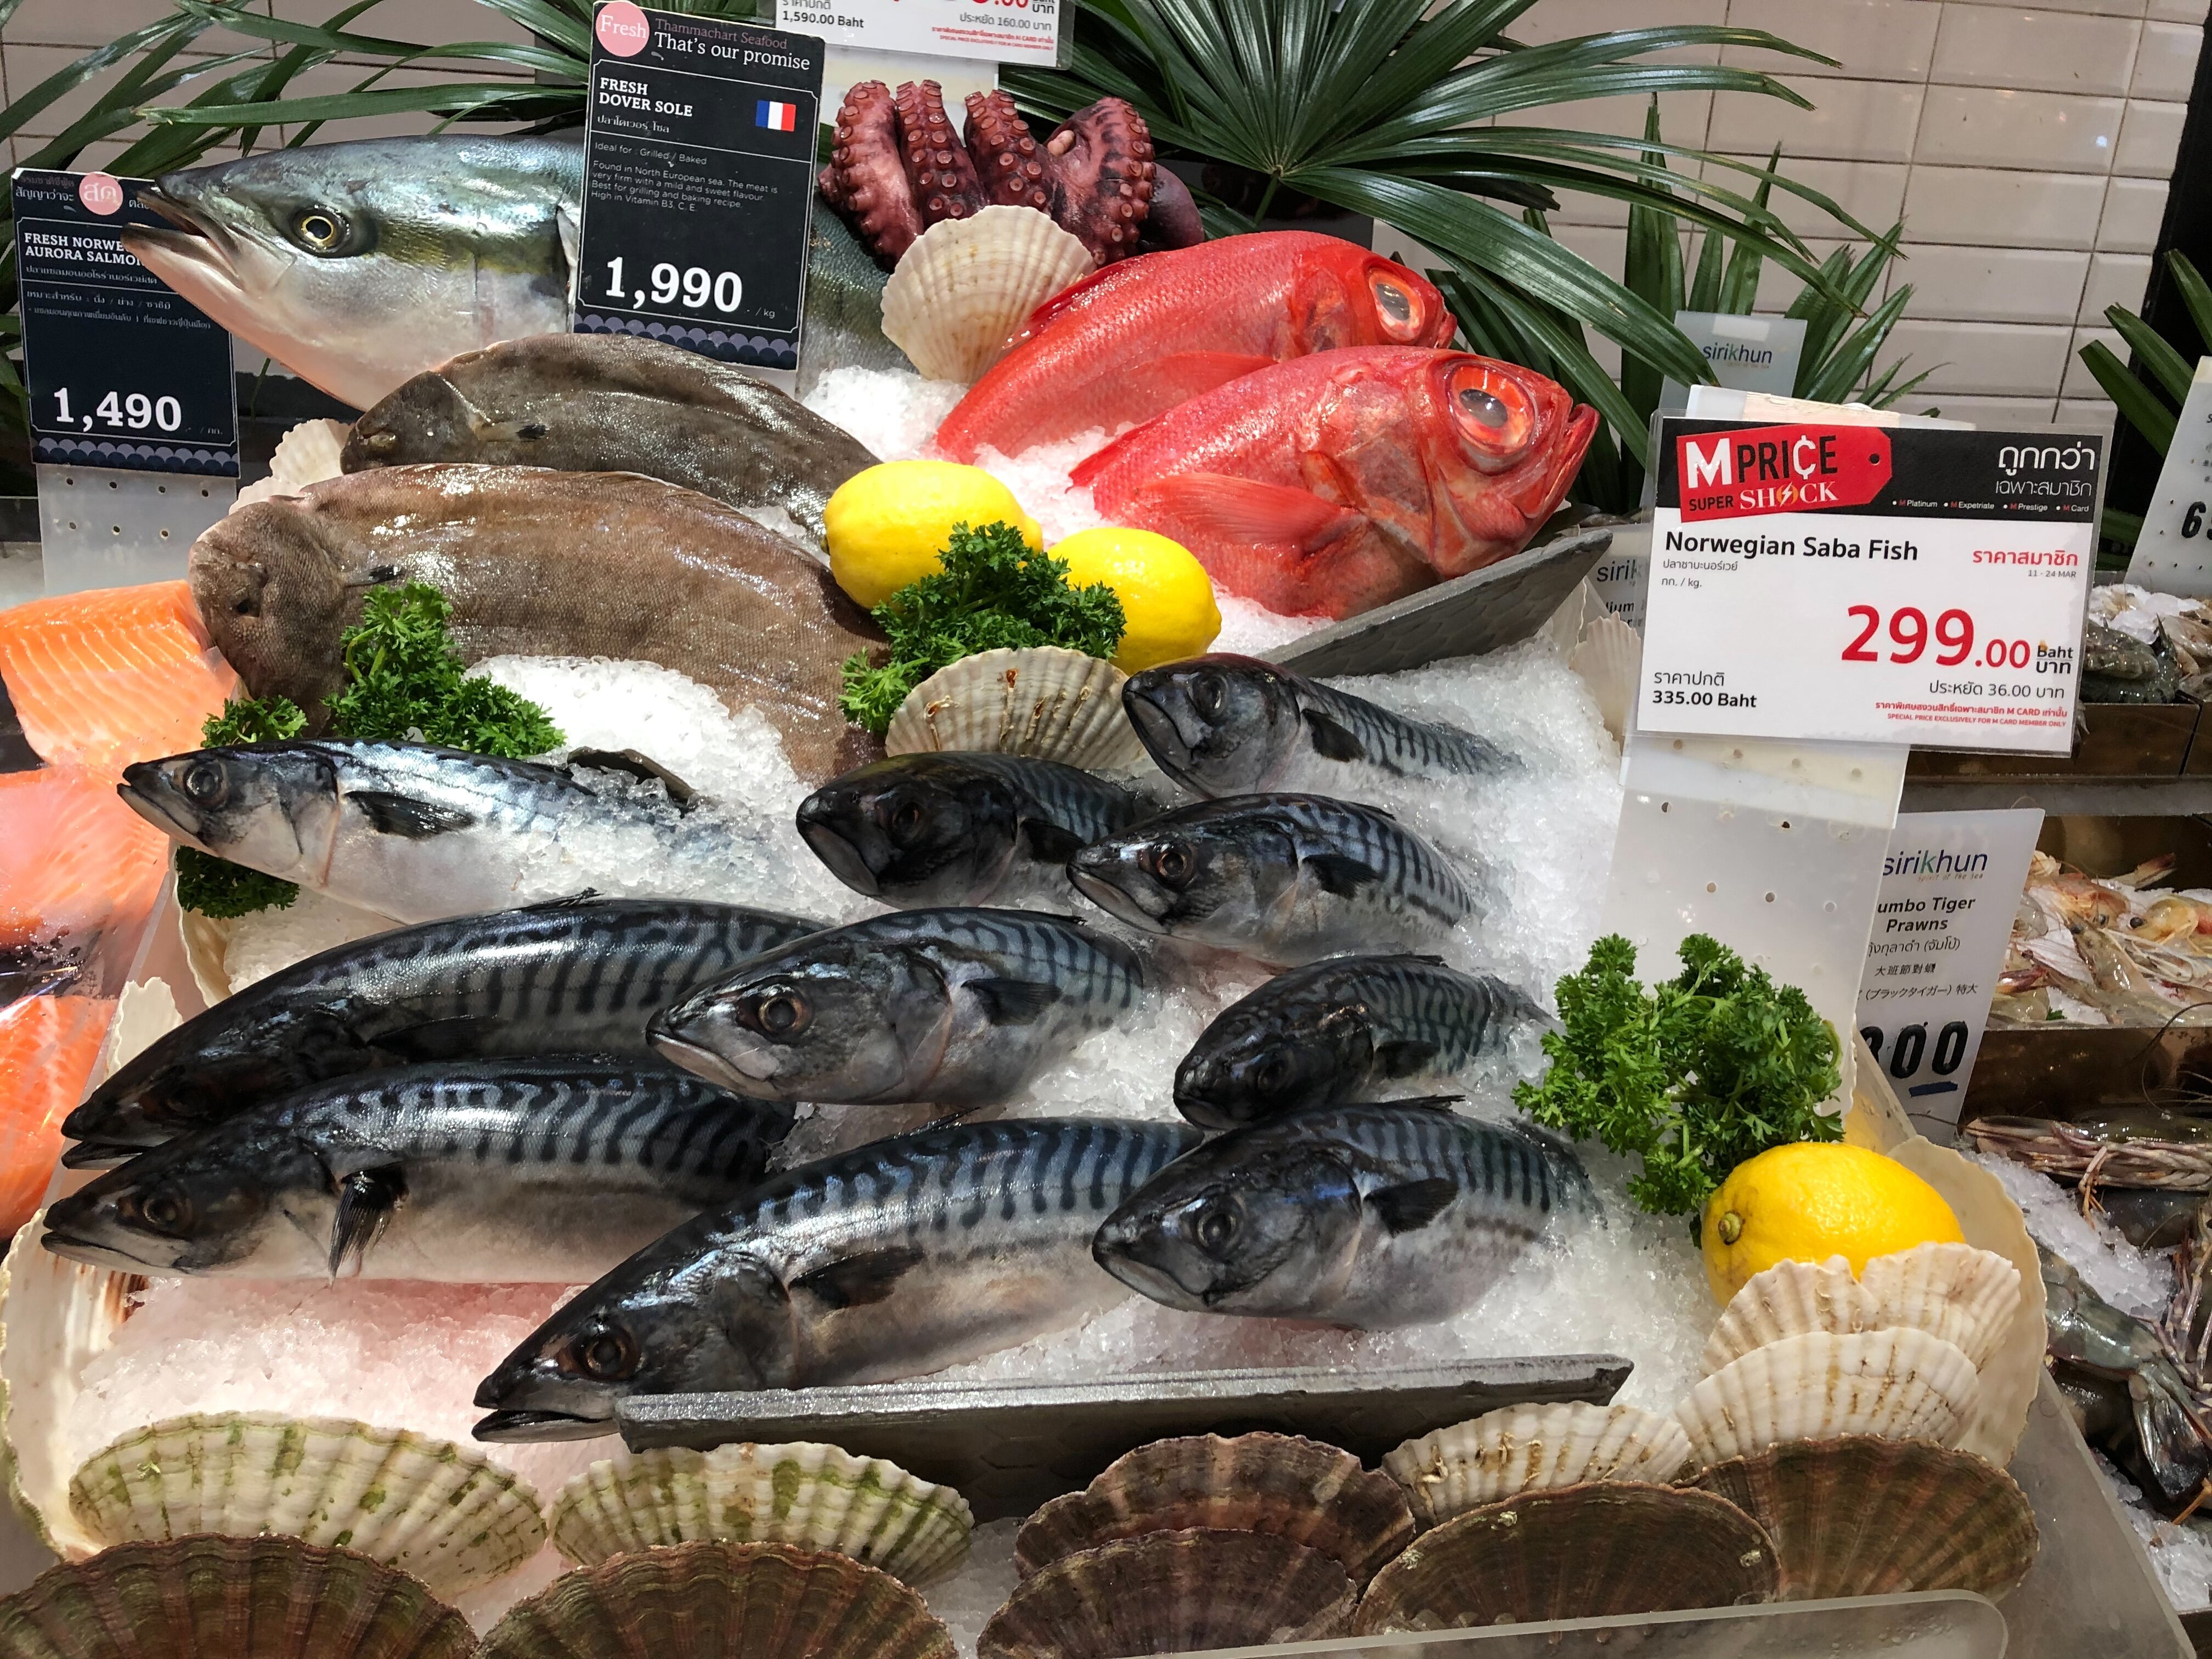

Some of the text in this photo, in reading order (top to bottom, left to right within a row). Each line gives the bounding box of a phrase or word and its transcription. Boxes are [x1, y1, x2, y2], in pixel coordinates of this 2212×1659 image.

[1032, 3, 1054, 14] บาท
[600, 14, 646, 38] Fresh
[782, 10, 864, 27] 1,590.00 Baht
[997, 17, 1031, 29] 160.00
[1033, 22, 1052, 31] บาท
[655, 18, 787, 49] Thammachart Seafood
[711, 45, 739, 59] our
[743, 50, 810, 70] promise
[600, 77, 648, 95] FRESH
[599, 92, 693, 117] DOVER SOLE
[595, 142, 617, 151] Ideal
[619, 145, 632, 154] for
[640, 148, 670, 159] Grilled
[679, 154, 707, 165] Baked
[592, 172, 612, 181] very
[614, 173, 632, 182] firm
[635, 177, 654, 185] with
[664, 182, 684, 190] mild
[686, 184, 703, 193] and
[705, 188, 730, 197] sweet
[593, 160, 622, 171] Found
[635, 166, 661, 177] North
[663, 171, 706, 183] European
[728, 179, 744, 189] The
[746, 184, 768, 193] meat
[591, 180, 611, 190] Best
[614, 183, 627, 191] for
[629, 187, 660, 198] grilling
[662, 191, 679, 199] and
[681, 193, 711, 205] baking
[591, 190, 612, 200] High
[625, 195, 659, 206] Vitamin
[24, 233, 125, 251] FRESH NORWE
[25, 246, 83, 261] AURORA
[606, 256, 743, 313] 1,990
[764, 308, 775, 319] kg
[1703, 342, 1773, 364] sirikhun
[54, 387, 182, 432] 1,490
[1999, 441, 2095, 476] ถูกกว่า
[1689, 481, 1839, 511] SUPER SHOCK
[1996, 479, 2092, 496] เฉพาะสมาชิก
[2181, 501, 2212, 541] 6
[1665, 531, 1918, 561] Norwegian Saba Fish
[1663, 559, 1738, 571] ปลาซาบะนอร์เวย์
[1972, 549, 2078, 566] ราคาสมาชิก
[2028, 569, 2038, 578] 11
[1662, 577, 1678, 587] กก.
[1688, 578, 1702, 589] kg.
[2036, 642, 2074, 659] Baht
[2036, 660, 2071, 674] บาท
[1654, 671, 1724, 686] ราคาปกติ
[1930, 680, 2064, 699] ประหยัด 36.00 บาท
[1652, 690, 1757, 708] 335.00 Baht
[1935, 715, 1976, 723] EXCLUSIVELY
[2017, 708, 2040, 716] CARD
[1883, 849, 1988, 876] sirikhun
[1877, 897, 1976, 913] umbo Tiger
[1886, 919, 1948, 932] Prawns
